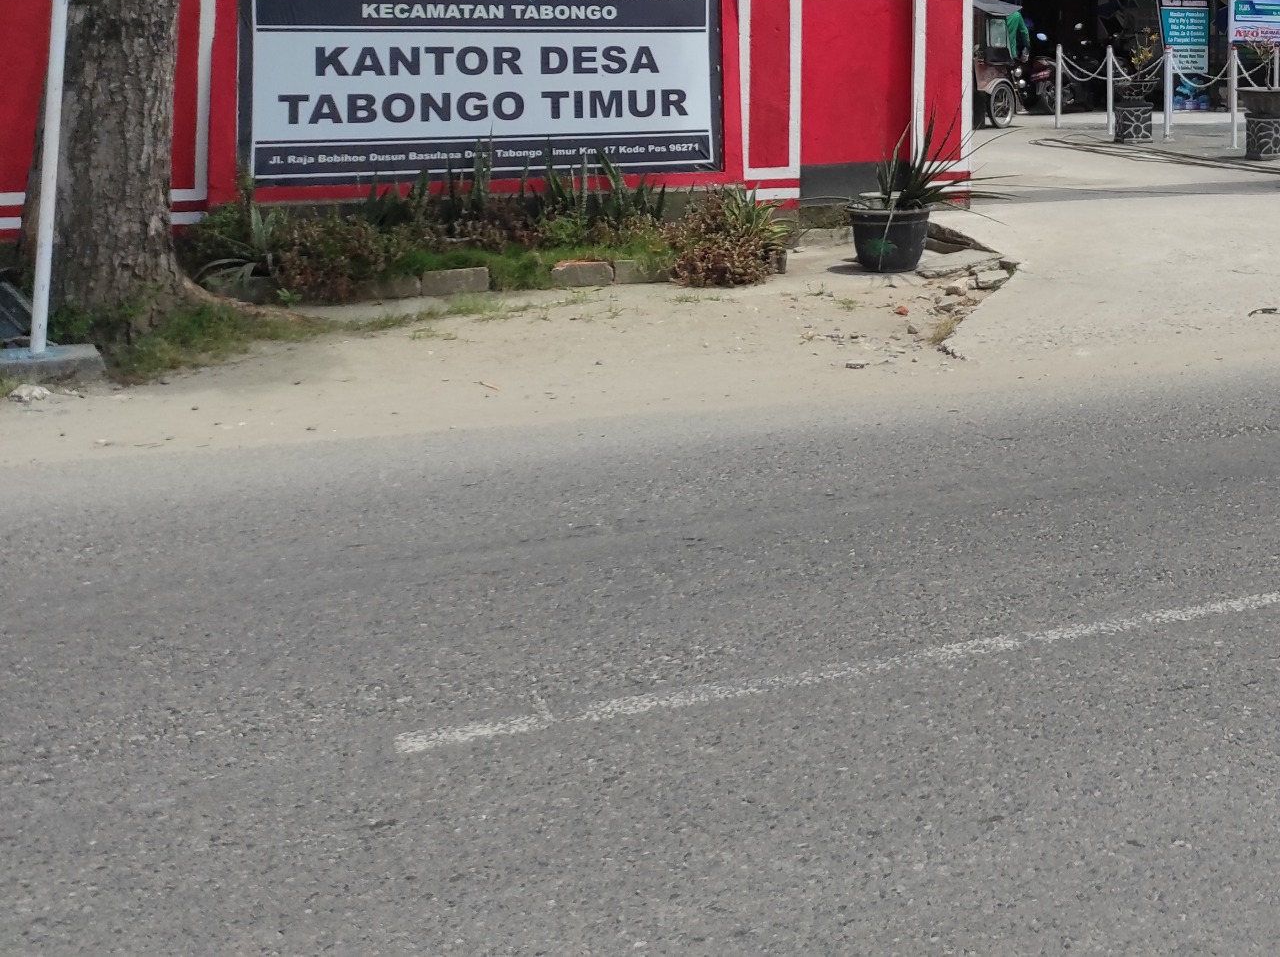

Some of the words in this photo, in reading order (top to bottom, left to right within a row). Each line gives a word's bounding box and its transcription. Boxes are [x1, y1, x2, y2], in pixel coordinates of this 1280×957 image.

[361, 3, 505, 19] KECAMATAN
[511, 5, 618, 20] TABONGO
[314, 45, 524, 77] KANTOR
[540, 45, 660, 75] DESA
[277, 90, 525, 125] TABONGO
[540, 88, 689, 119] TIMUR
[269, 155, 285, 165] Jl.
[287, 154, 315, 166] Raja
[318, 152, 367, 164] Bobihoe
[369, 152, 406, 163] Dusun
[495, 149, 543, 159] Tabongo
[545, 147, 577, 156] imur
[579, 146, 597, 155] Km
[603, 145, 616, 154] 17
[618, 144, 646, 154] Kode
[648, 143, 667, 153] Pos
[669, 142, 700, 152] 96271
